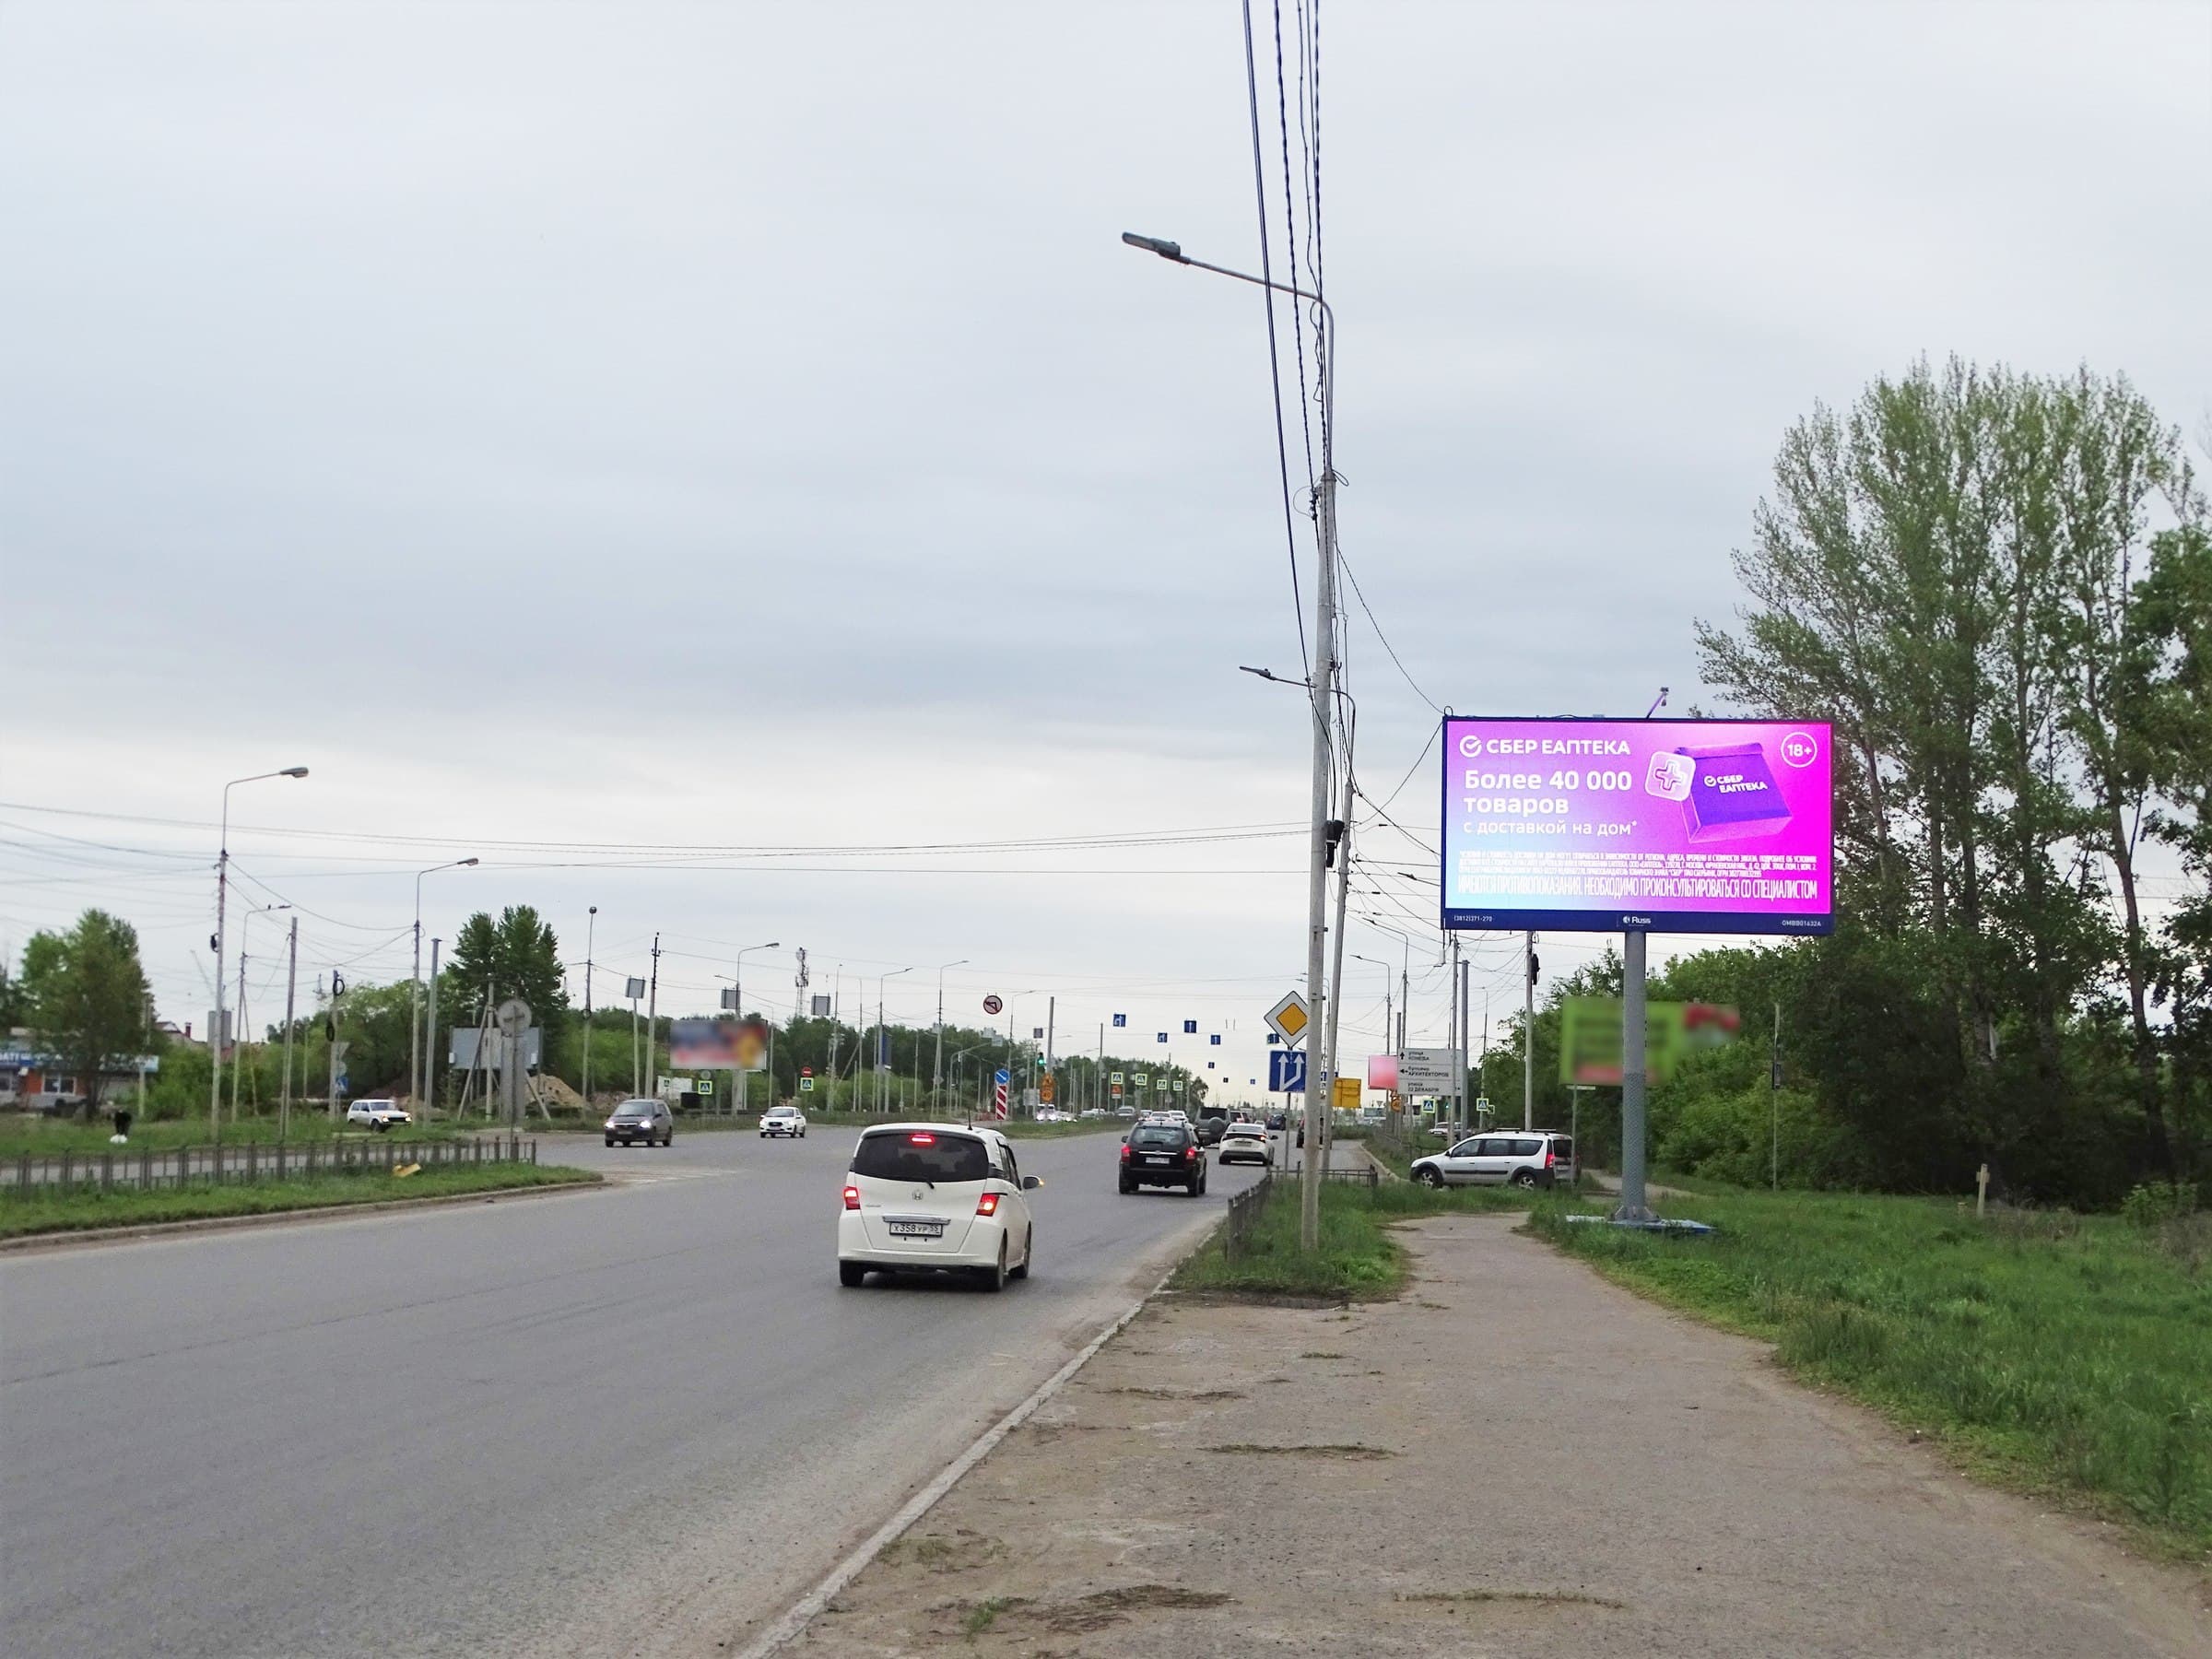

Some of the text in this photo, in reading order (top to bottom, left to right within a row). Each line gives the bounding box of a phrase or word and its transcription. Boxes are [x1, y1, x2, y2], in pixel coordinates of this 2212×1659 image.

[1486, 738, 1631, 756] СБЕР ЕАПТЕКА
[1786, 743, 1813, 757] 18+
[1464, 770, 1632, 791] Более 40 000
[1716, 774, 1744, 784] СБЕР
[1719, 781, 1769, 794] ЕАПТЕКА
[1464, 797, 1569, 818] товаров
[1464, 821, 1472, 834] с
[1477, 819, 1567, 836] доставкой
[1572, 822, 1592, 835] на
[1584, 877, 1640, 900] НЕОБХОДИМО
[1641, 877, 1739, 898] ПРОКОНСУЛЬТИРОВАТЬСЯ
[1741, 879, 1751, 898] СО
[1752, 878, 1818, 902] СПЕЦИАЛИСТОМ
[1631, 916, 1652, 924] Russ
